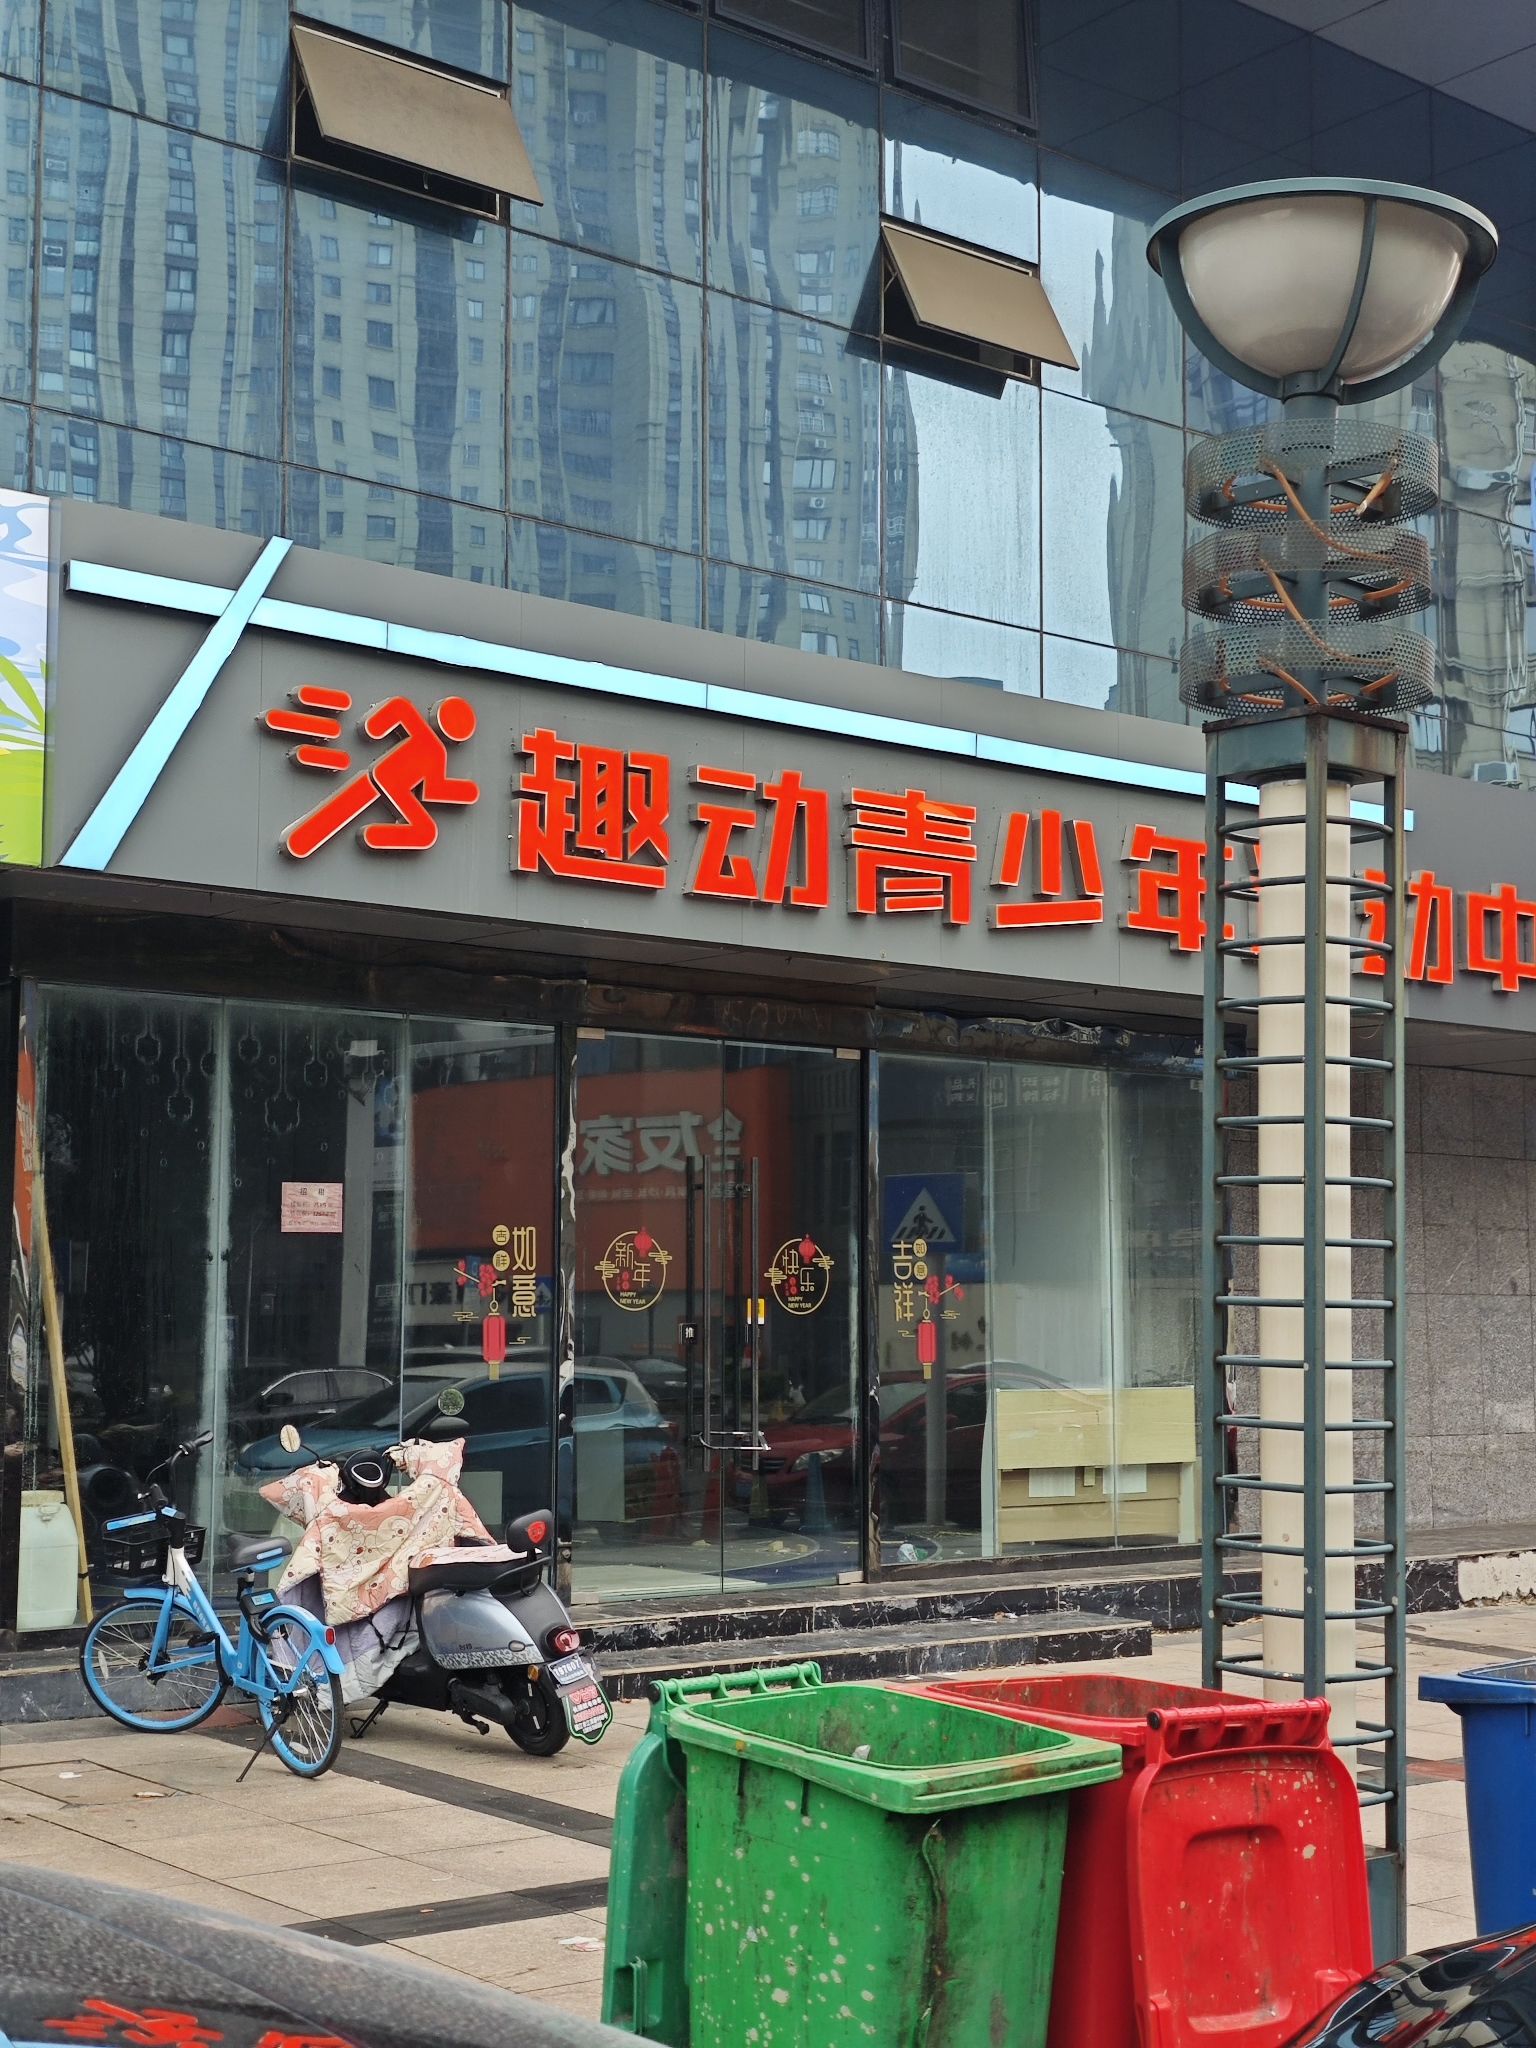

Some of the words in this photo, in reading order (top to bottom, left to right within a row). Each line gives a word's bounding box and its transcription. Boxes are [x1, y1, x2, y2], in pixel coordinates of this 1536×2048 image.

[513, 727, 1536, 993] 趣动青少年动中
[512, 1226, 537, 1318] 如意
[615, 1240, 651, 1288] 新年
[782, 1248, 815, 1292] 快乐
[892, 1240, 914, 1322] 吉祥
